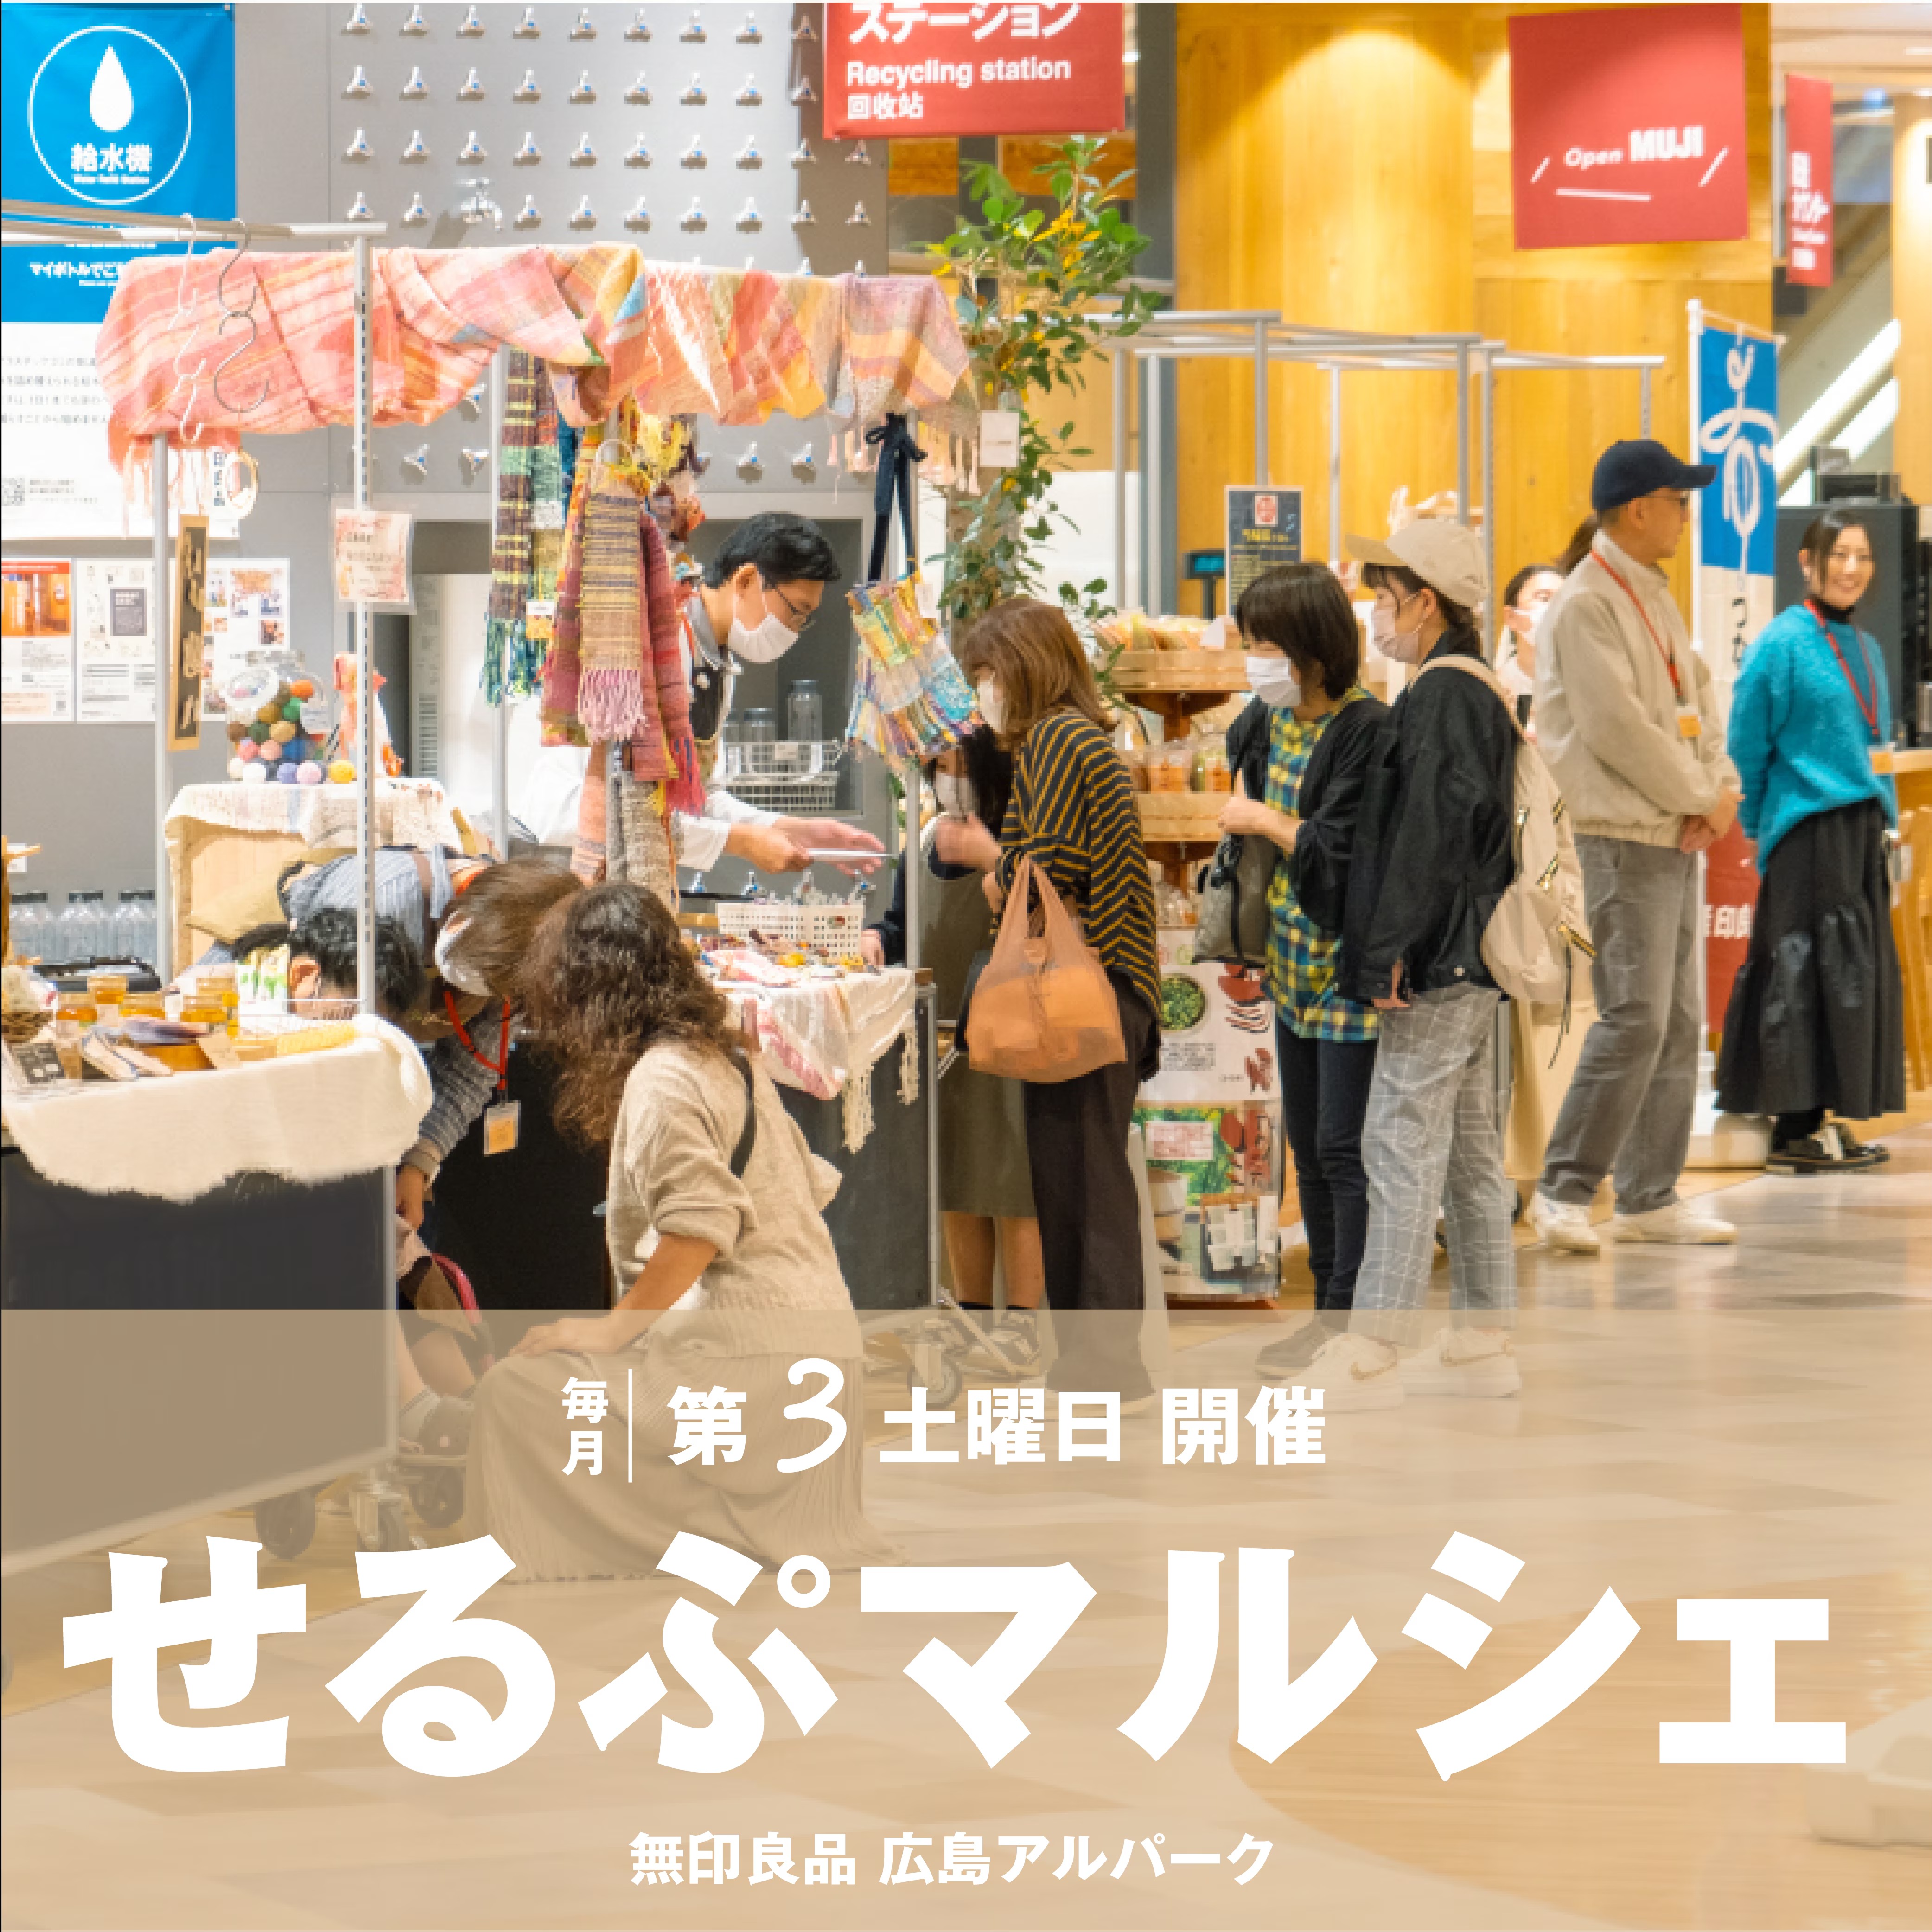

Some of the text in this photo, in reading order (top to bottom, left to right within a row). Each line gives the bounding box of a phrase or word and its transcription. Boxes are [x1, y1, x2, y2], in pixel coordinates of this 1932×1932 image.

[847, 56, 1071, 91] Recycling station
[1564, 124, 1705, 171] Open MUJI
